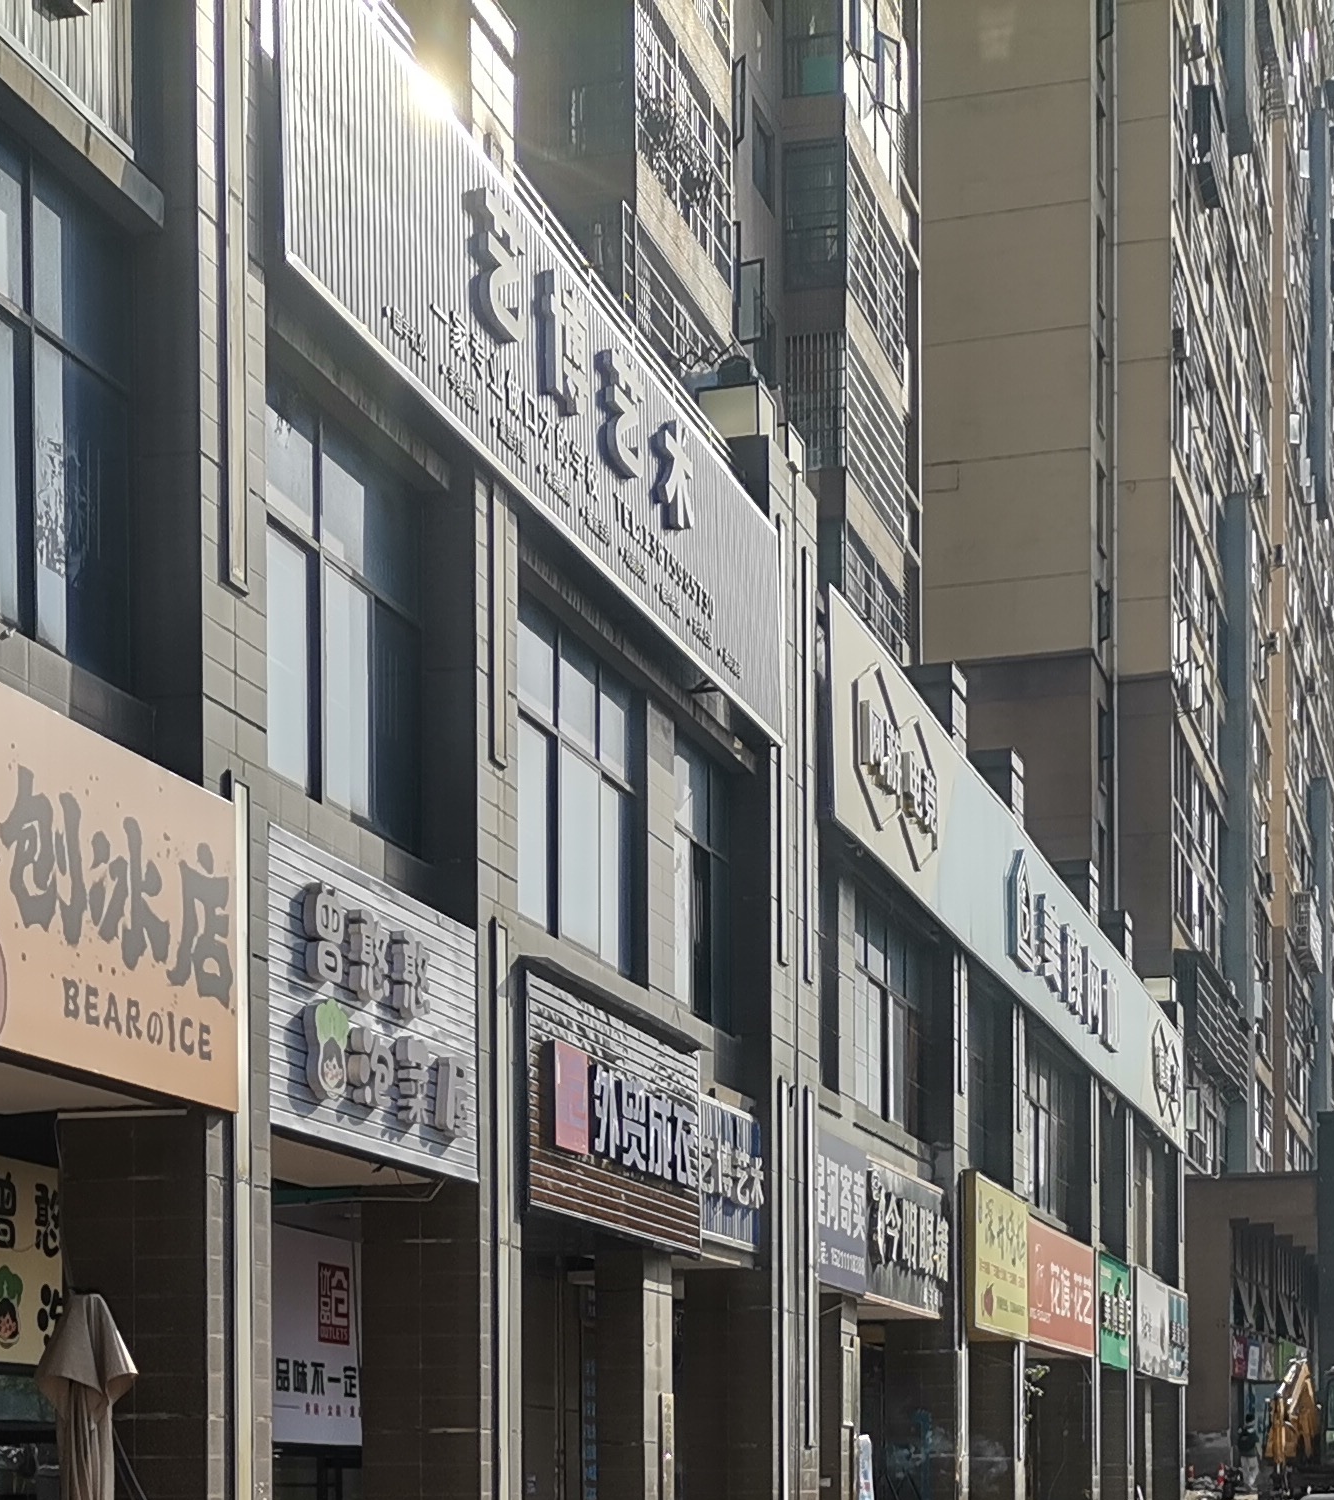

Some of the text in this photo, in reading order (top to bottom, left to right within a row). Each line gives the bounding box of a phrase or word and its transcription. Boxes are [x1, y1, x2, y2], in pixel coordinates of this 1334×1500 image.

[463, 186, 696, 532] 艺博艺术
[302, 881, 430, 1019] 曾憨憨
[346, 1026, 469, 1138] 泡菜屋
[593, 1064, 699, 1189] 外贸成衣
[885, 1192, 949, 1282] 今明眼镜
[275, 1357, 358, 1399] 品味不一定
[319, 1327, 349, 1342] OUTLETS
